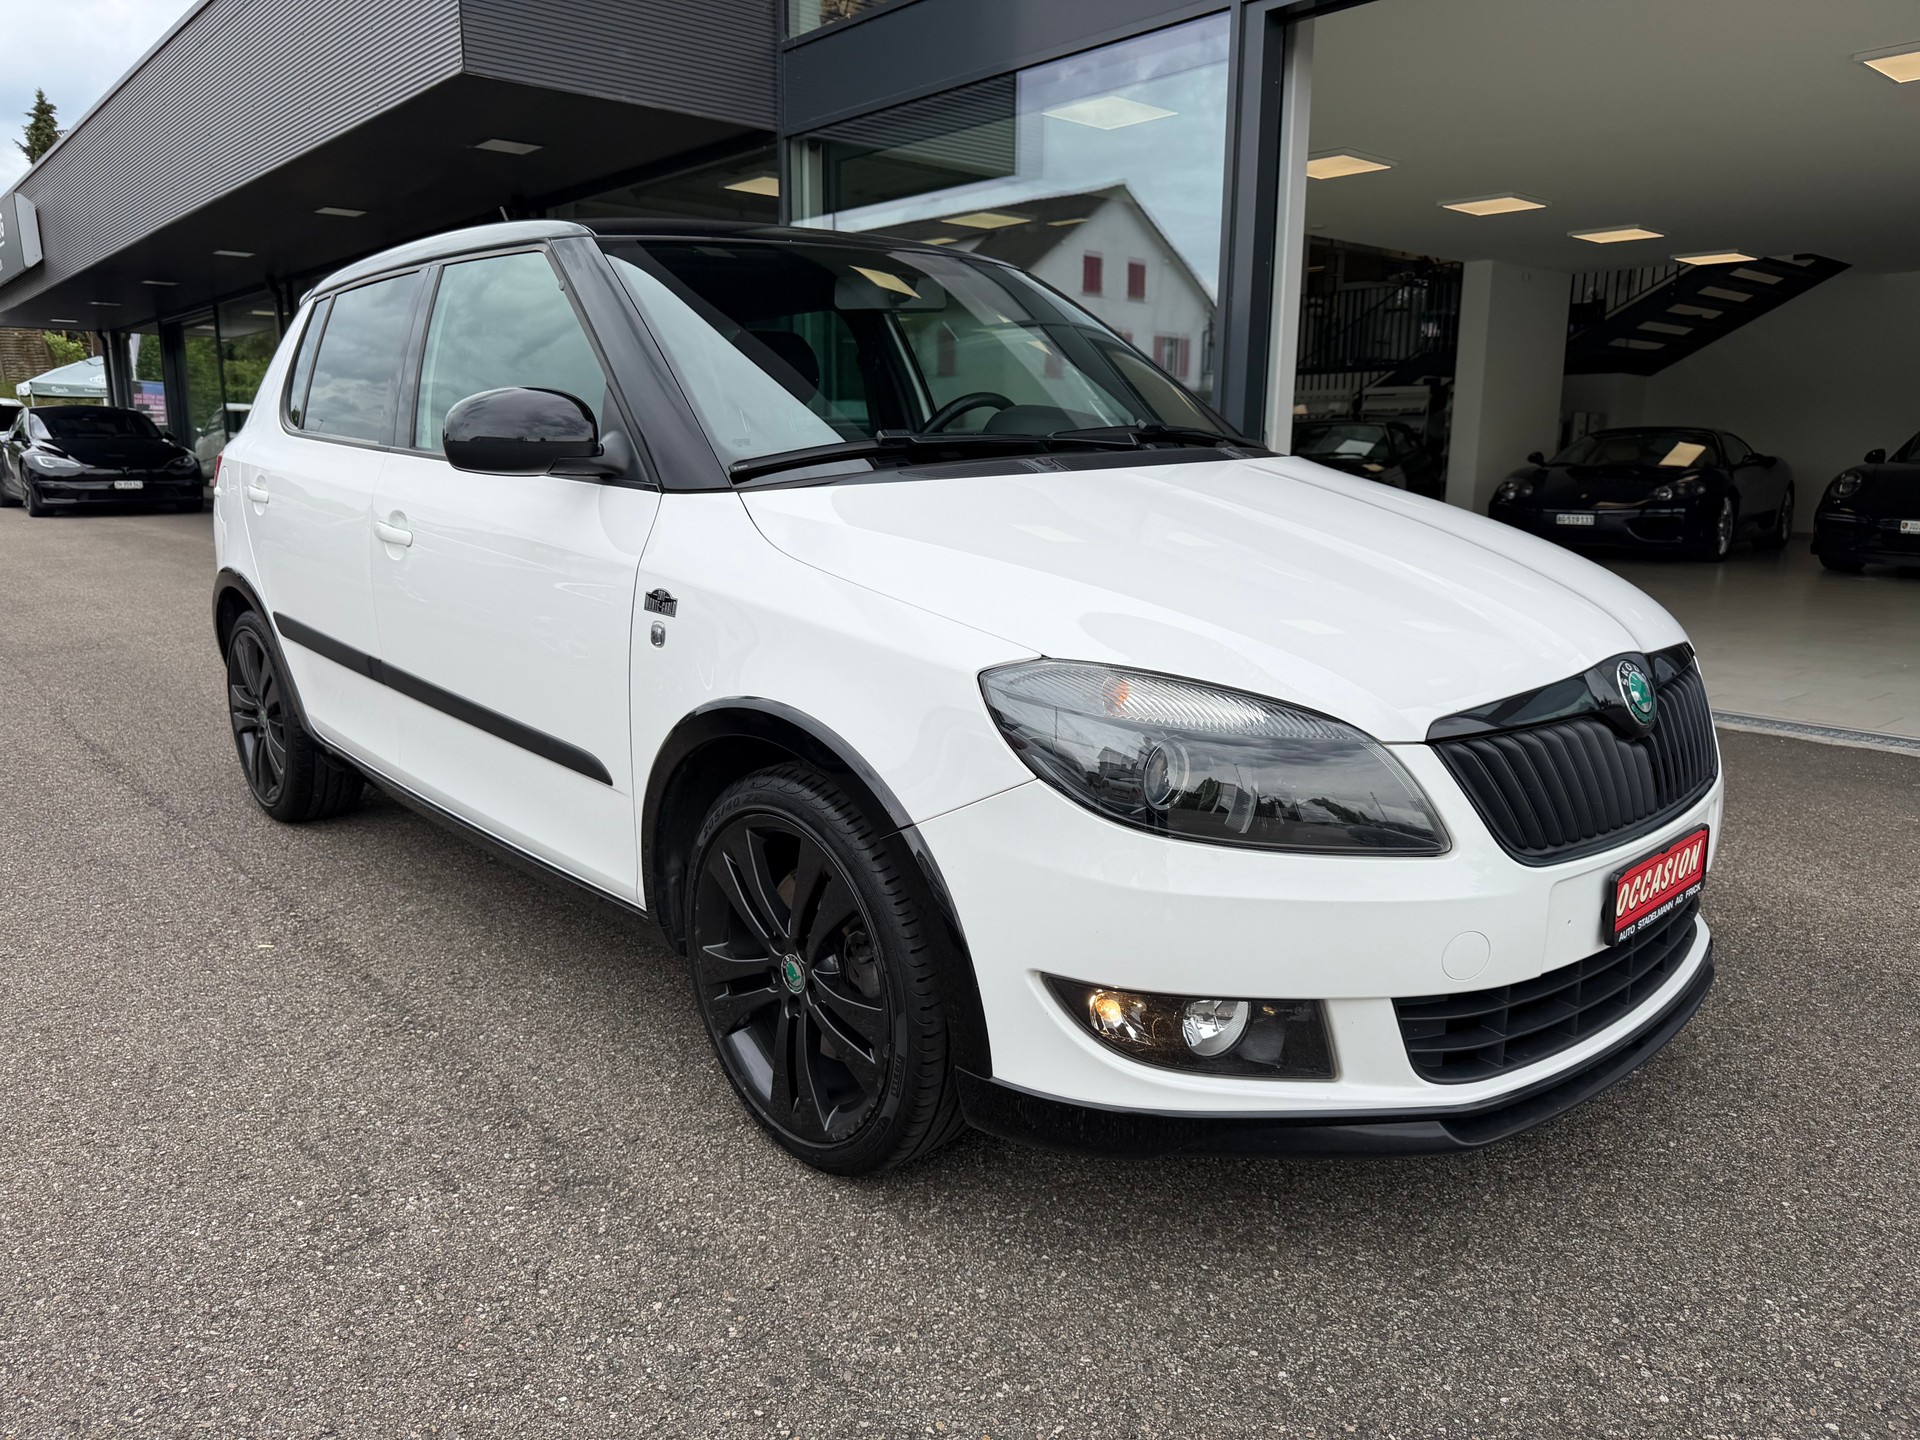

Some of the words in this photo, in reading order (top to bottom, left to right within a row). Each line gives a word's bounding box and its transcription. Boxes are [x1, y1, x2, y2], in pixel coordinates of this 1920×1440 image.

[1616, 839, 1703, 918] OCCASION
[1618, 924, 1636, 943] AUTO
[1637, 899, 1674, 930] STADELMANN
[1674, 893, 1684, 906] AG
[1685, 881, 1701, 899] FRICK
